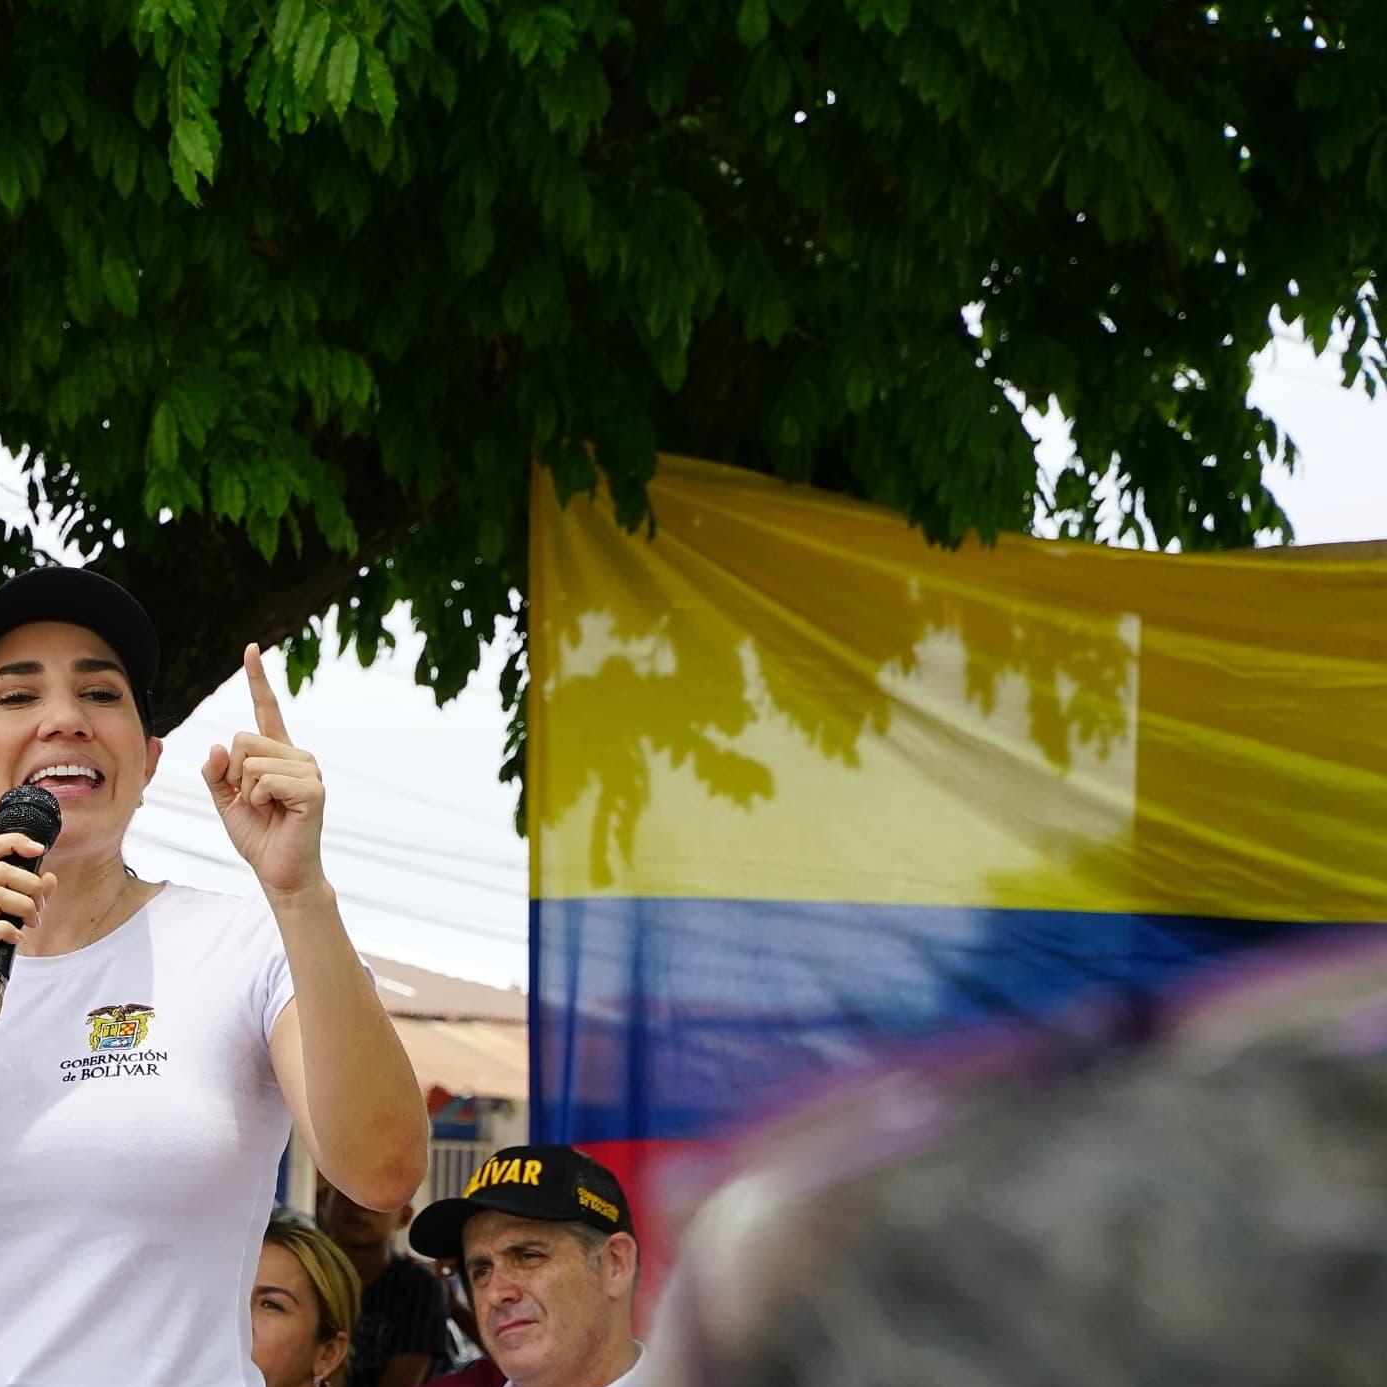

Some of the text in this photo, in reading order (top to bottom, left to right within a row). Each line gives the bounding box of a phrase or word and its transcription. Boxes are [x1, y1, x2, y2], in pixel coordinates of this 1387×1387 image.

[60, 1049, 167, 1070] GOBERNACIÓN
[62, 1063, 160, 1082] de BOLÍVAR
[463, 1156, 542, 1199] LÍVAR
